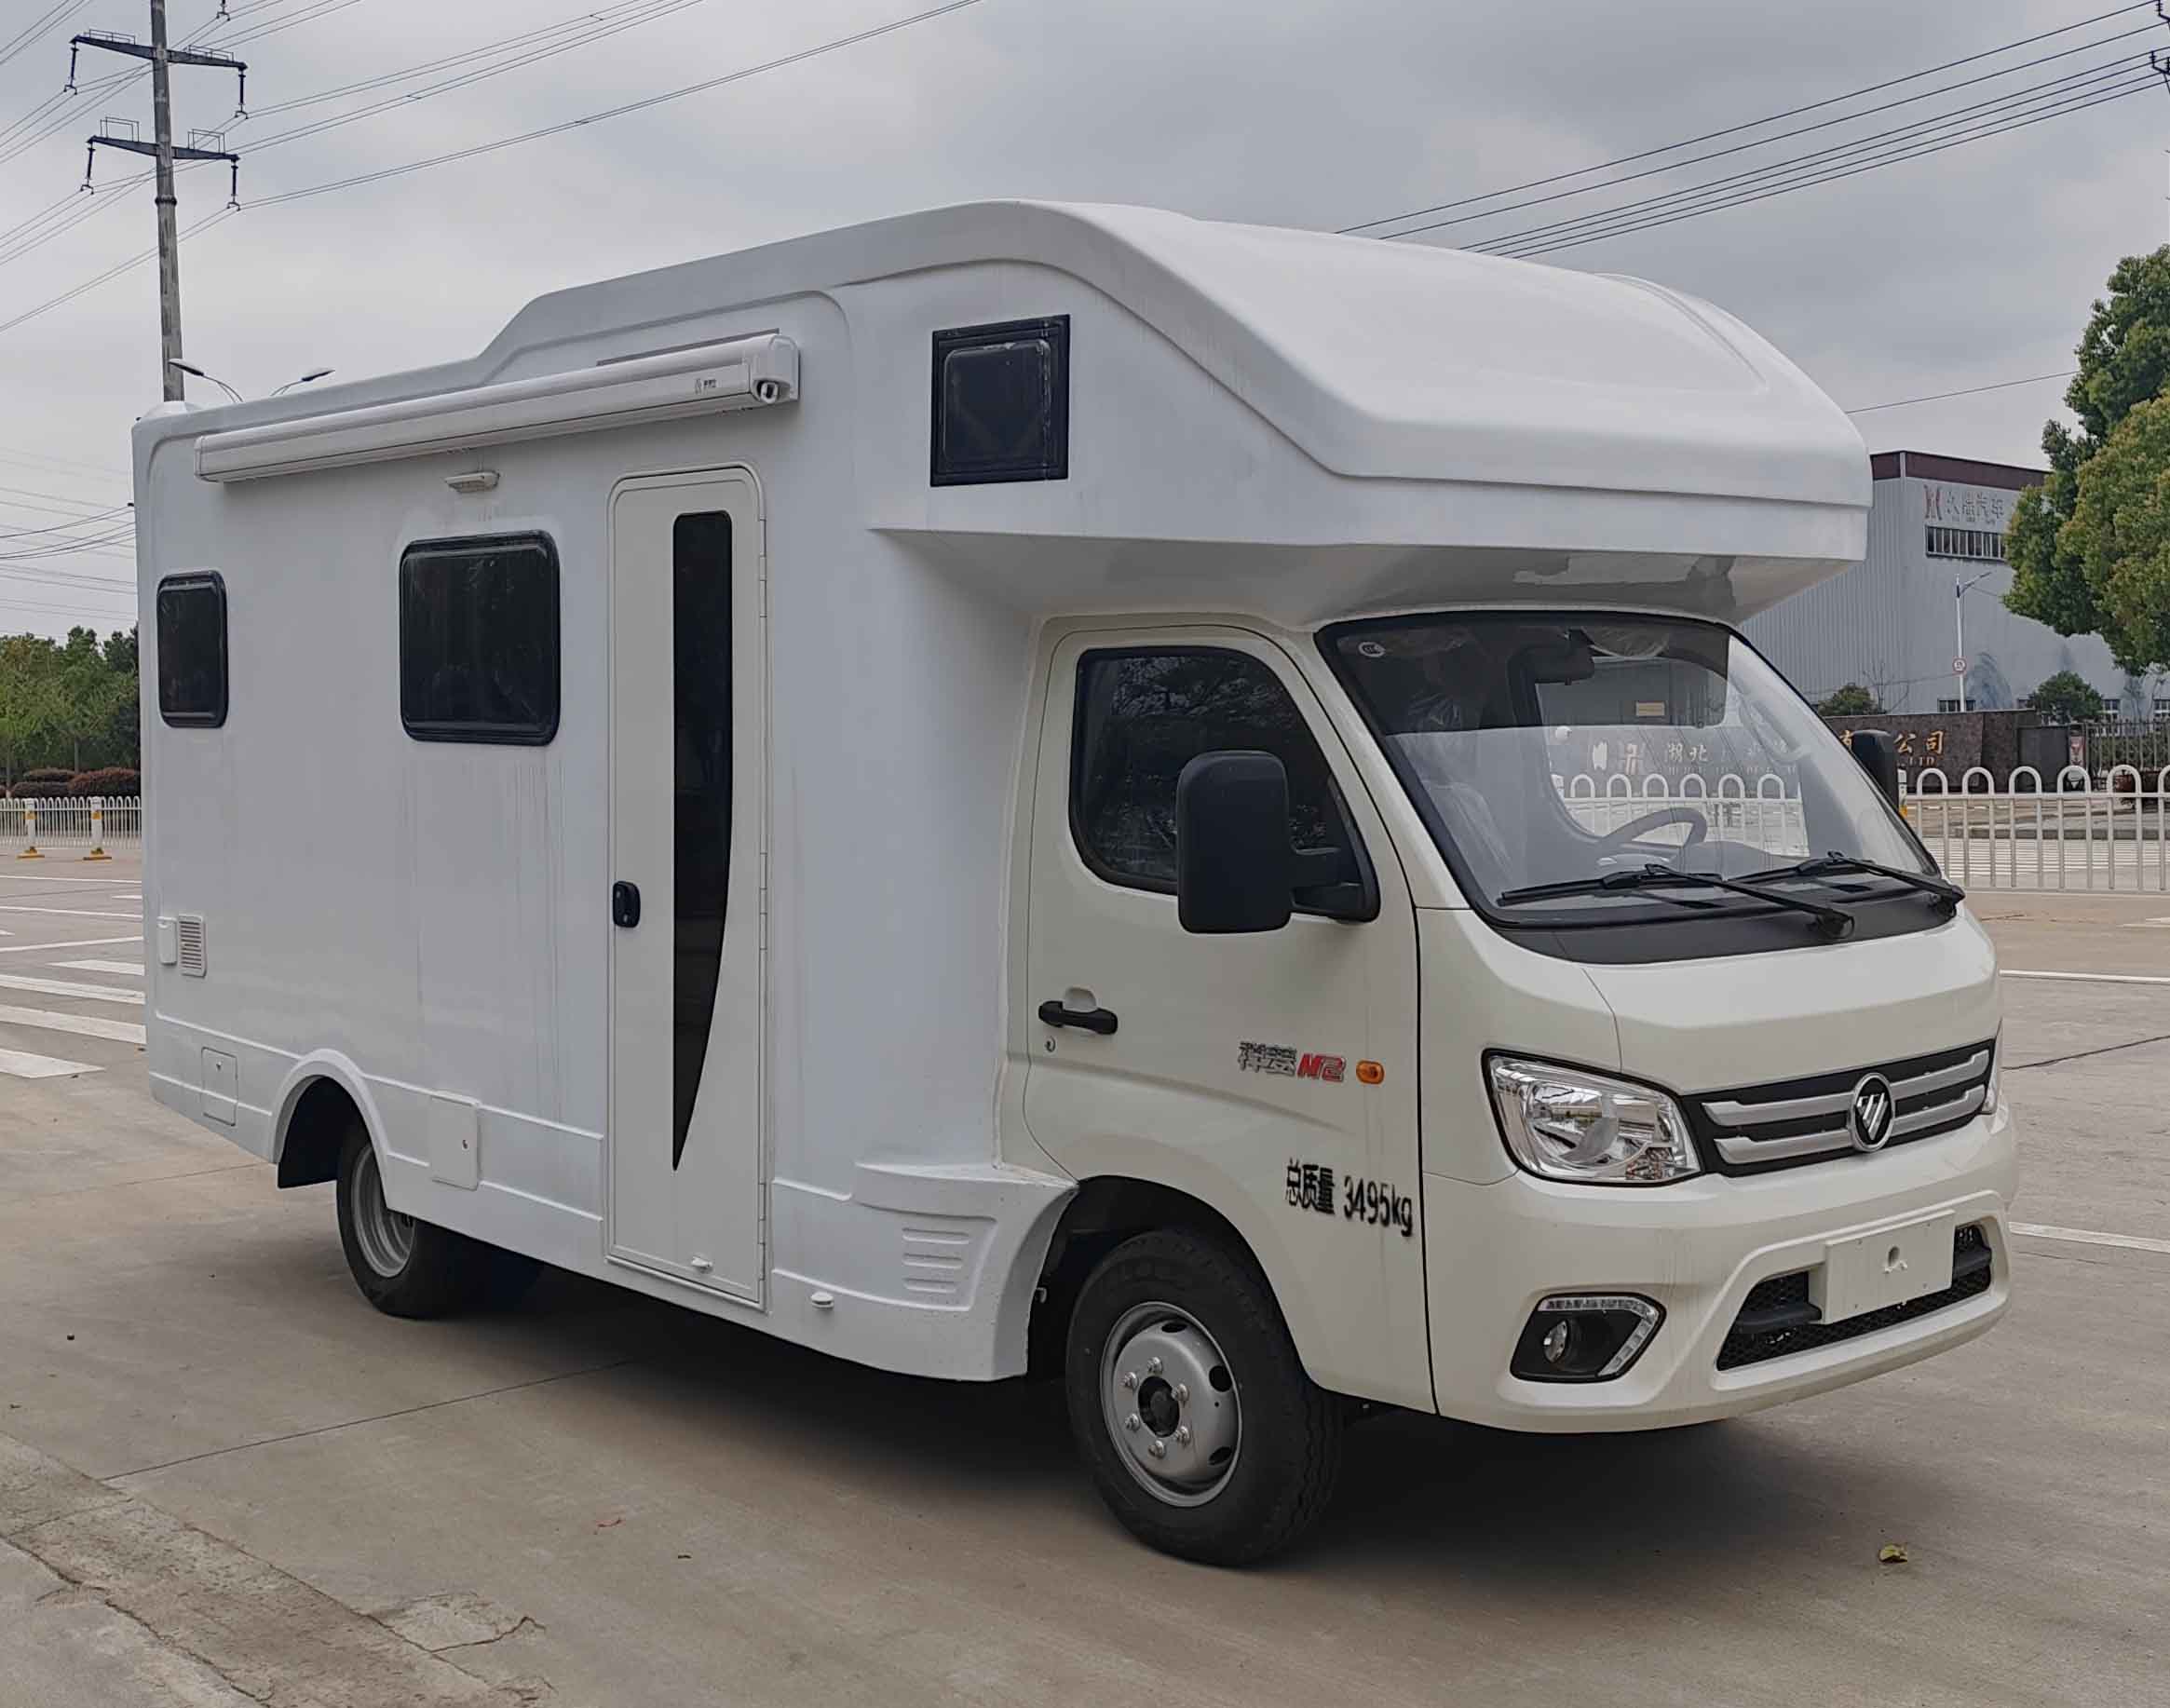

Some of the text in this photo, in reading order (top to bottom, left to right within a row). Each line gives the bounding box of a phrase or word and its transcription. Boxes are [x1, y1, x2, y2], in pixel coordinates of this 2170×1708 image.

[1892, 730, 1945, 754] 公司
[1285, 1158, 1414, 1239] 总质量 3495kg
